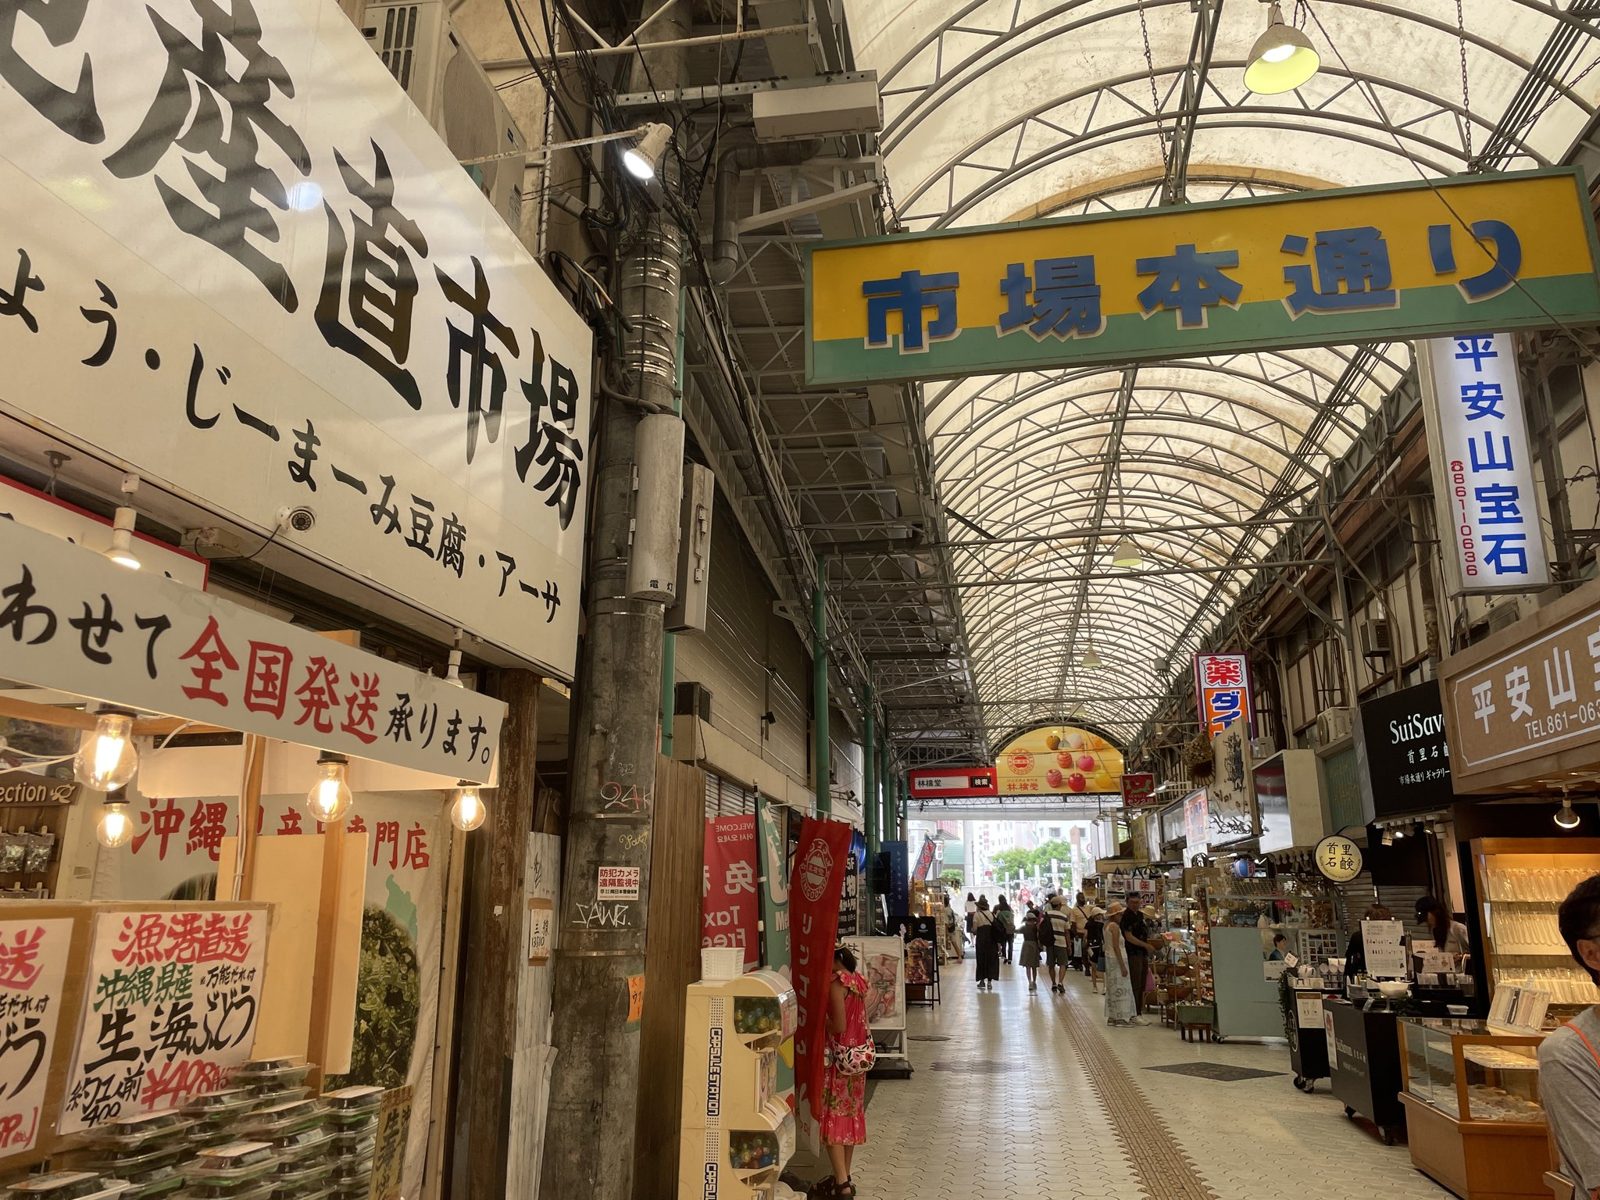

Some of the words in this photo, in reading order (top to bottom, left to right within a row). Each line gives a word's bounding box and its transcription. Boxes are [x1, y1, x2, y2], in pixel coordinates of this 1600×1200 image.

[862, 217, 1523, 354] 市場本通り
[1453, 334, 1529, 575] 平安山宝石
[1205, 656, 1243, 686] 薬
[1211, 690, 1241, 738] ダイ
[1389, 713, 1446, 745] SuiSav
[599, 868, 639, 878] 防犯カメラ
[599, 878, 639, 888] 遠隔監視中
[111, 911, 253, 967] 漁港直送
[93, 961, 195, 1013] 沖縄県産
